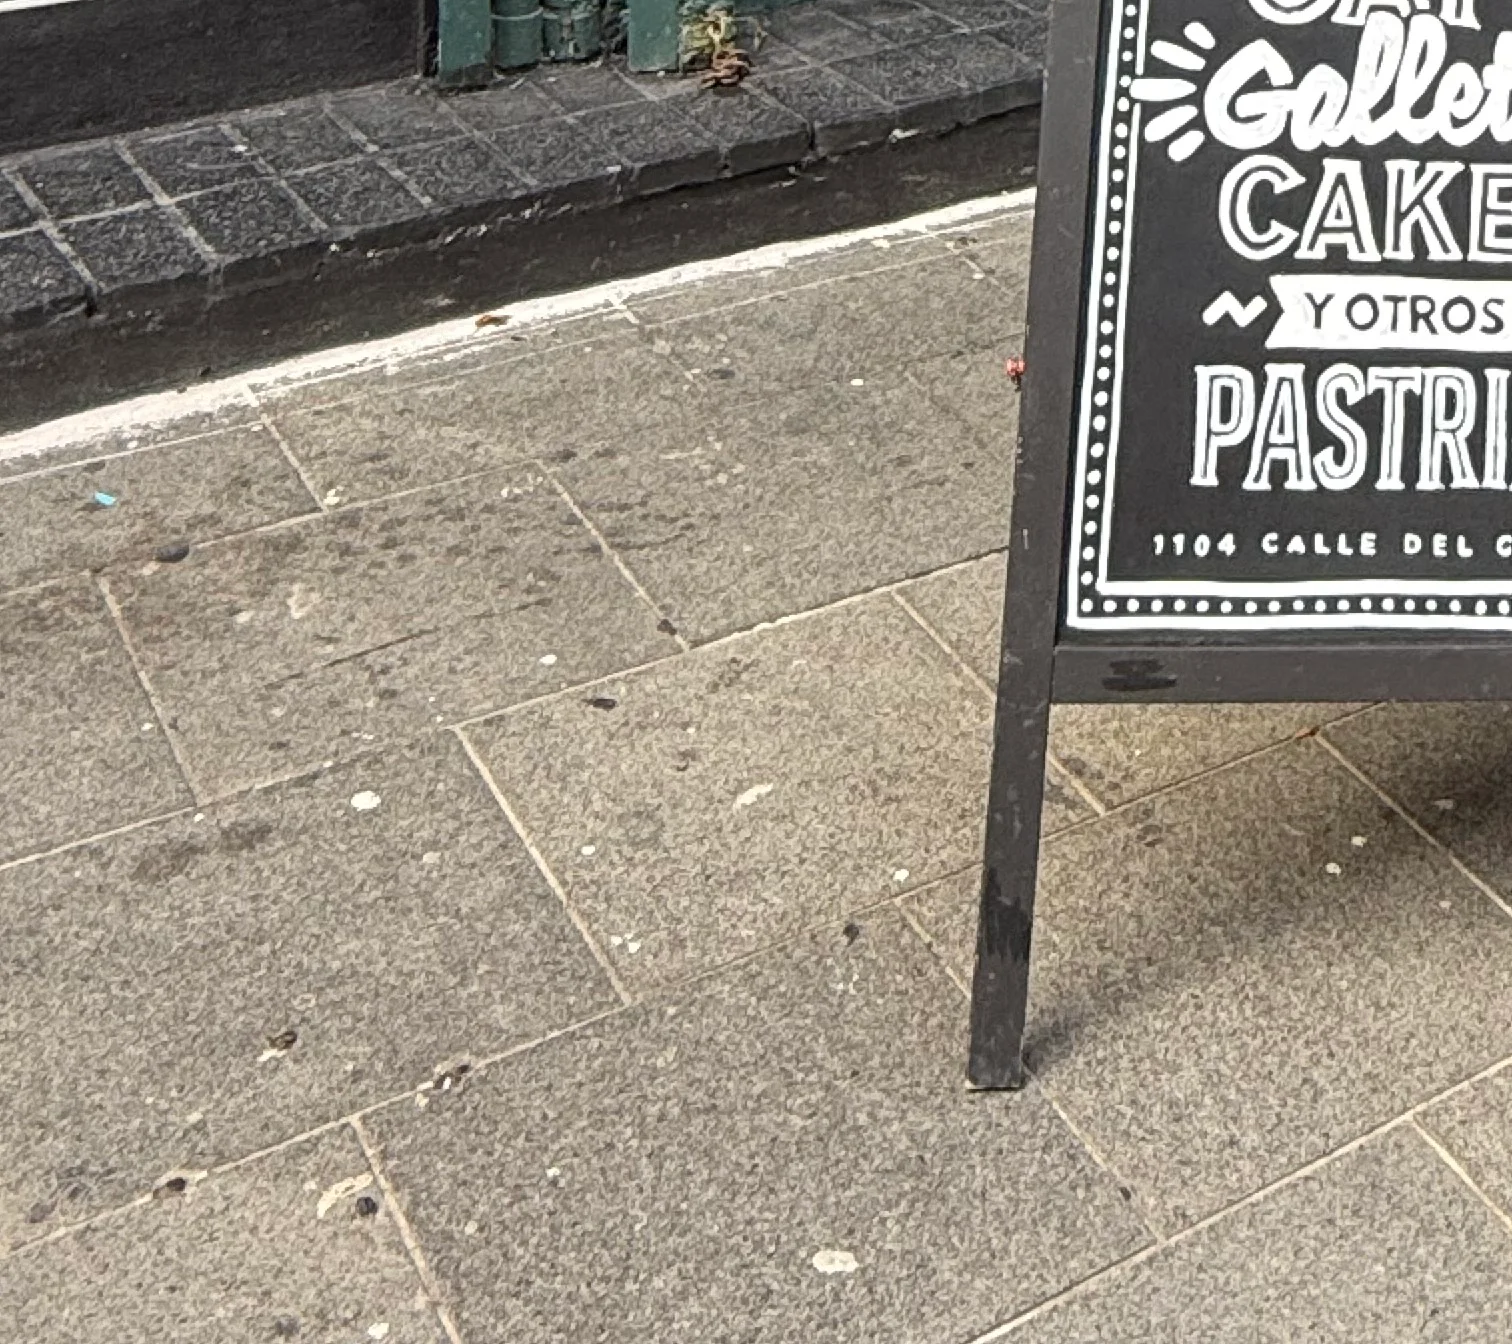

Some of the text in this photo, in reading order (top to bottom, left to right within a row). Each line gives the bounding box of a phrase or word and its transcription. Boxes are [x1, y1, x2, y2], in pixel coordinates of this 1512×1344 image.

[1303, 291, 1506, 335] Y OTROS
[1152, 532, 1237, 558] 1104
[1260, 531, 1378, 556] CALLE
[1402, 531, 1474, 558] DEL
